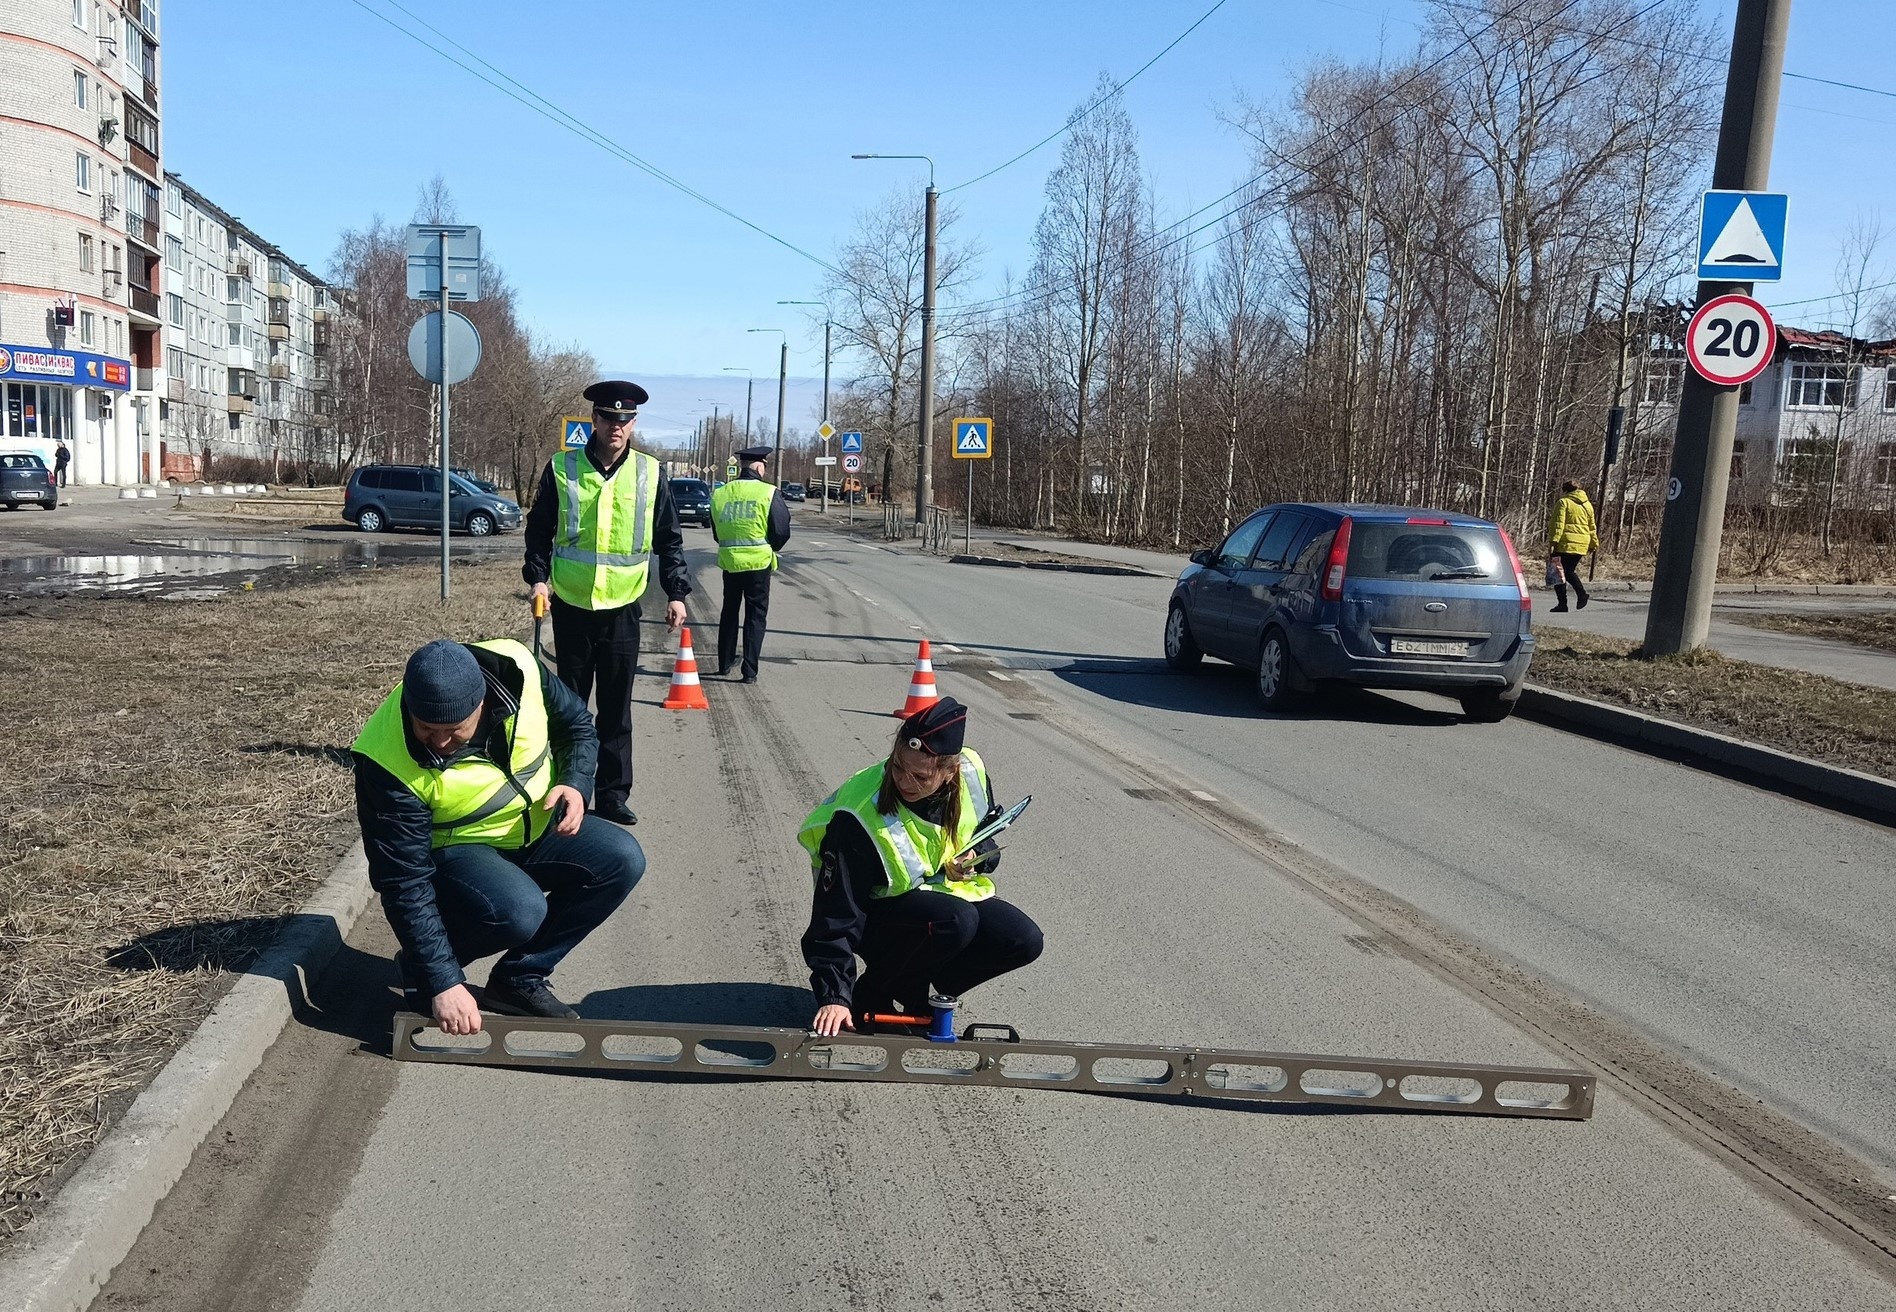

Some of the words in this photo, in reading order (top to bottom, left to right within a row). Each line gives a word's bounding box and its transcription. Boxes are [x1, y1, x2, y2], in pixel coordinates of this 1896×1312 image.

[1703, 317, 1760, 358] 20
[15, 352, 45, 366] ПИВАС
[48, 356, 54, 367] И
[57, 357, 74, 369] КВАС
[846, 458, 858, 467] 20
[719, 501, 756, 523] ДПС
